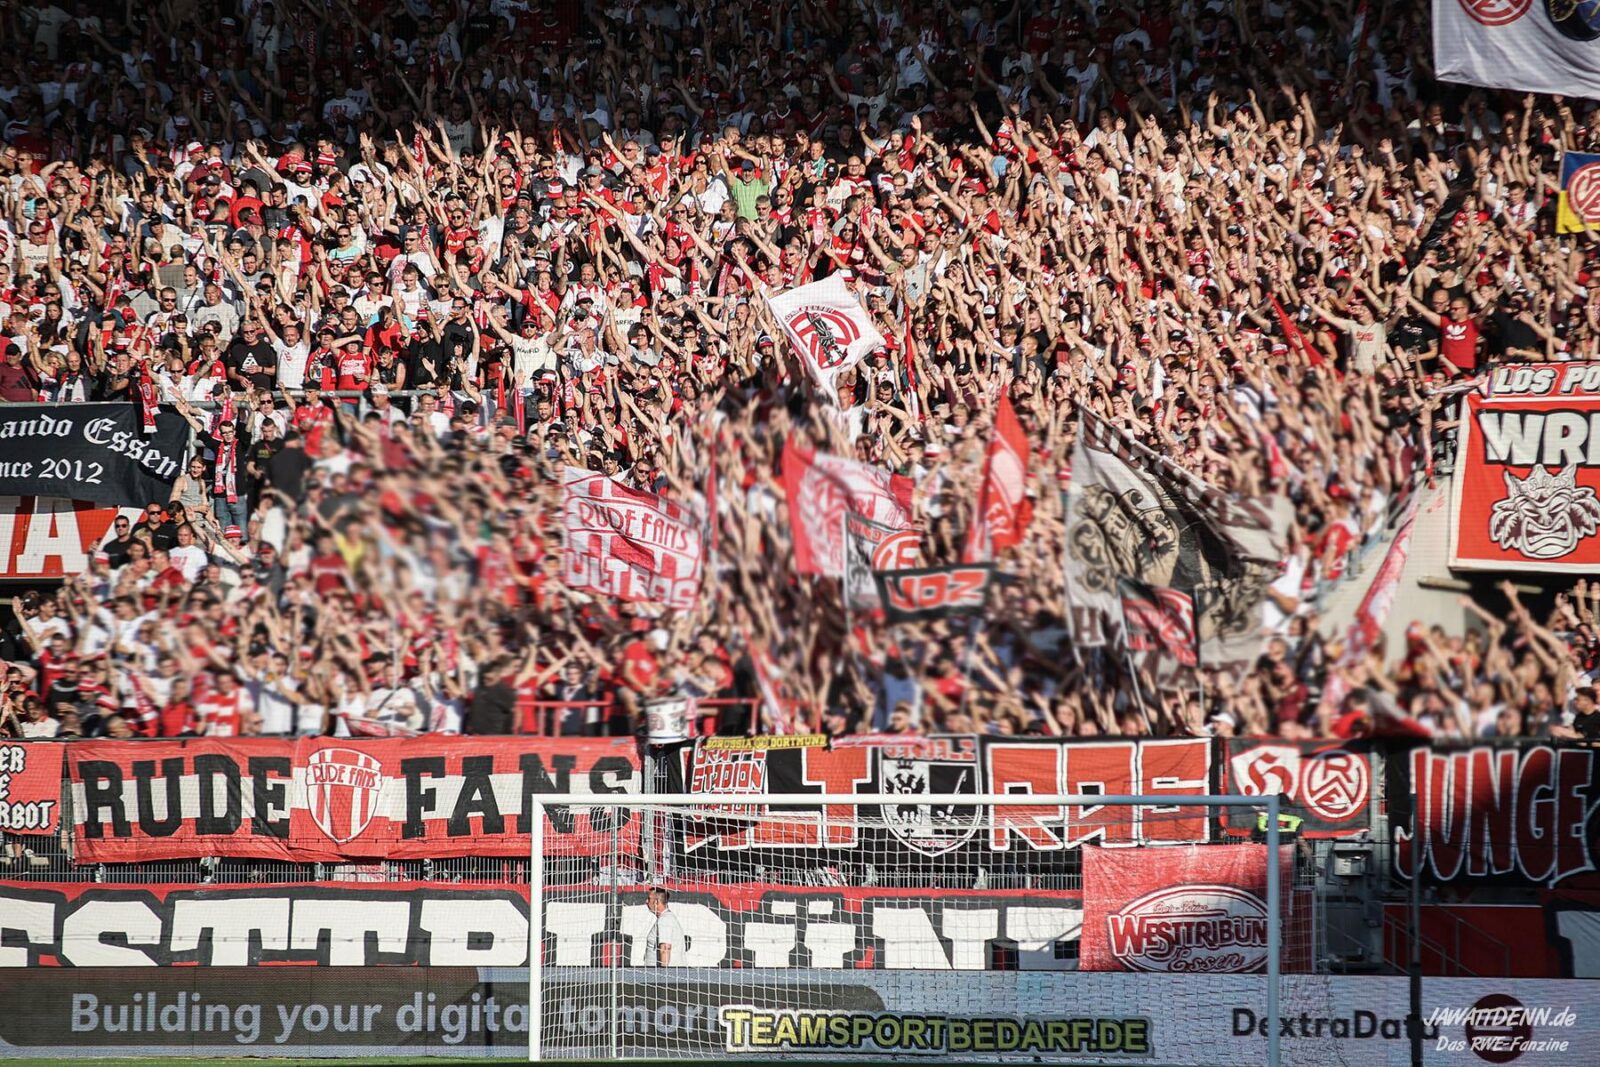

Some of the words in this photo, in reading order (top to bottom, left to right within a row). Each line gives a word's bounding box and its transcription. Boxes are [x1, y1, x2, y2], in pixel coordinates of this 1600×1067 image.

[1494, 368, 1555, 394] LOS
[0, 414, 74, 439] ando
[83, 418, 178, 477] Essen
[1478, 411, 1600, 465] WR
[38, 457, 104, 485] 2012
[578, 502, 637, 537] RUDE
[641, 511, 688, 550] FANS
[564, 551, 699, 610] ULTRAS
[769, 735, 827, 748] DORTMUND
[78, 753, 291, 839] RUDE
[400, 752, 636, 840] FANS
[312, 764, 346, 783] RUDE
[348, 767, 378, 788] FANS
[691, 761, 767, 794] STADION
[1394, 746, 1598, 890] JUNGE
[1108, 913, 1282, 959] WESTTRIBÜN
[1168, 946, 1245, 973] Essen
[71, 992, 262, 1044] Building
[274, 1002, 383, 1044] your
[395, 992, 530, 1044] digita
[725, 1011, 1149, 1052] TEAMSPORTBEDARF.DE
